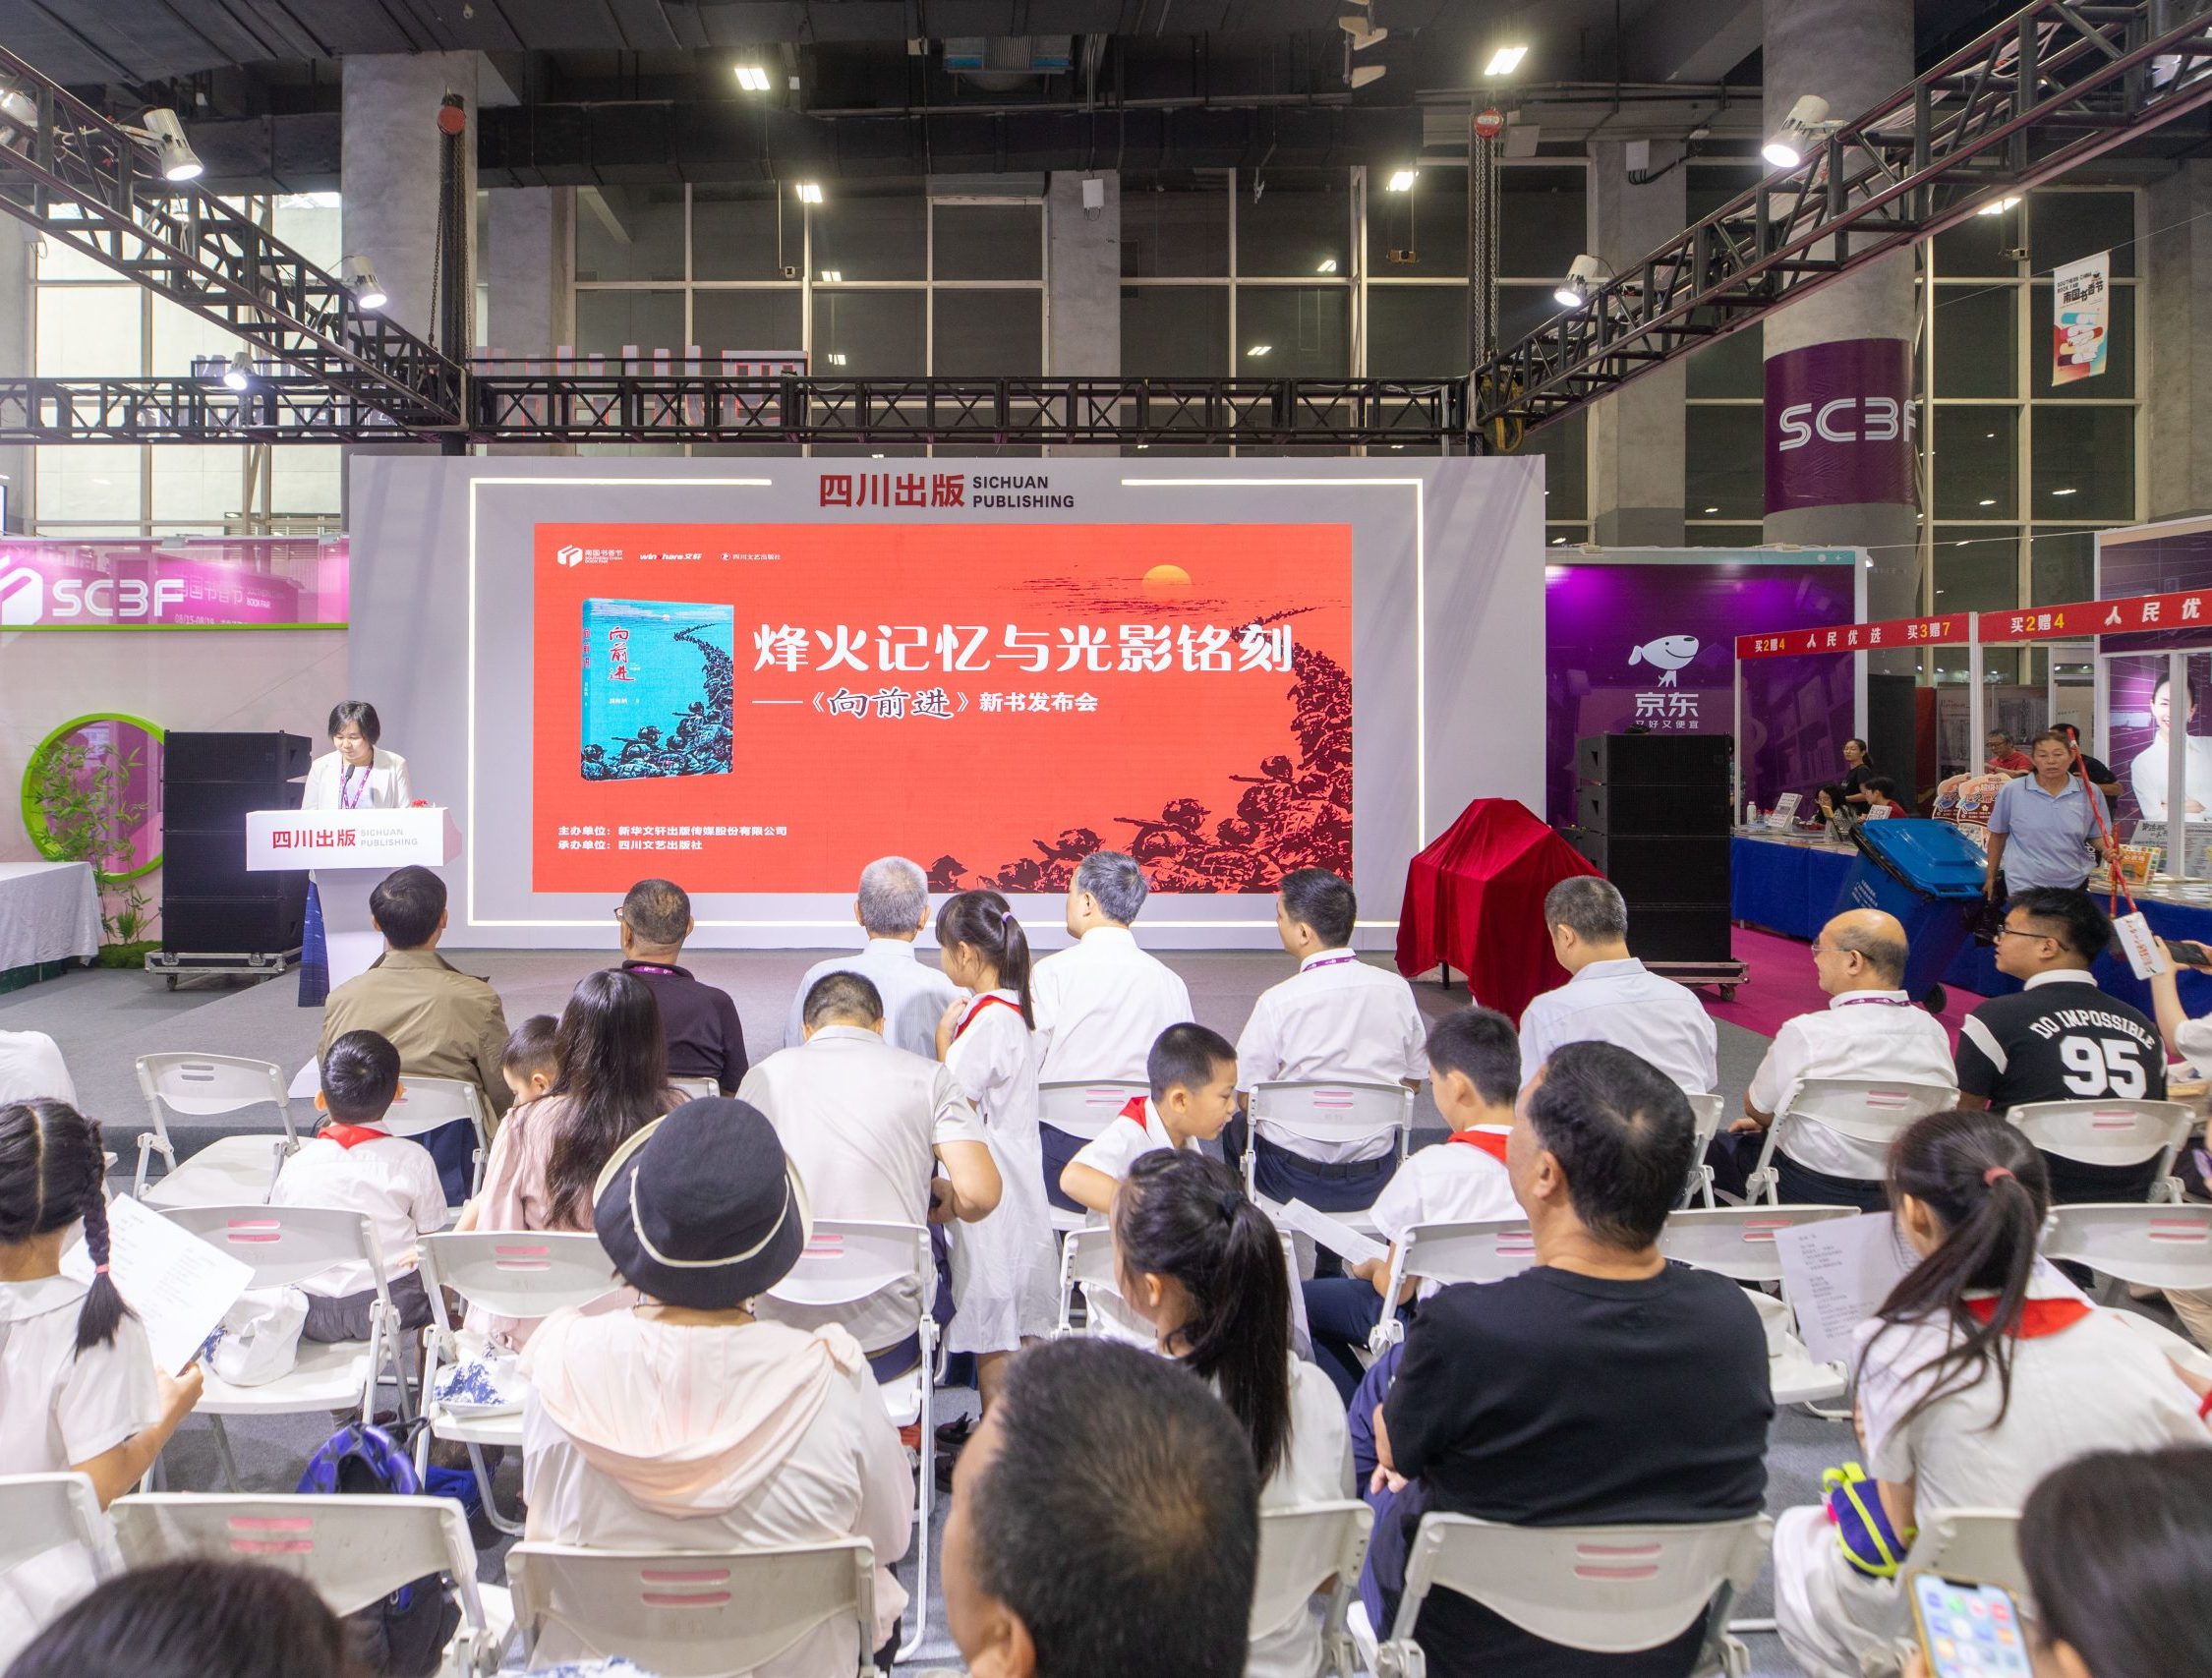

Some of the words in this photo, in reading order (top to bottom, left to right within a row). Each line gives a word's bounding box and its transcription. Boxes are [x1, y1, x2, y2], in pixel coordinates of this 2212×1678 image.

[2063, 280, 2104, 305] 南国书香节
[819, 473, 965, 507] 四川出版
[972, 476, 1049, 490] SICHUAN
[972, 494, 1075, 508] PUBLISHING
[1907, 621, 1951, 640] 买3赠7
[2010, 612, 2065, 634] 买2赠4
[609, 626, 636, 681] 向前进
[753, 624, 1294, 673] 烽火记忆与光影铭刻
[1635, 692, 1699, 718] 京东
[272, 829, 357, 849] 四川出版
[360, 829, 404, 838] SICHUAN
[360, 838, 419, 847] PUBLISHING
[2028, 1015, 2061, 1040] DO
[2055, 1009, 2156, 1050] IMPOSSIBLE
[2059, 1035, 2147, 1099] 95
